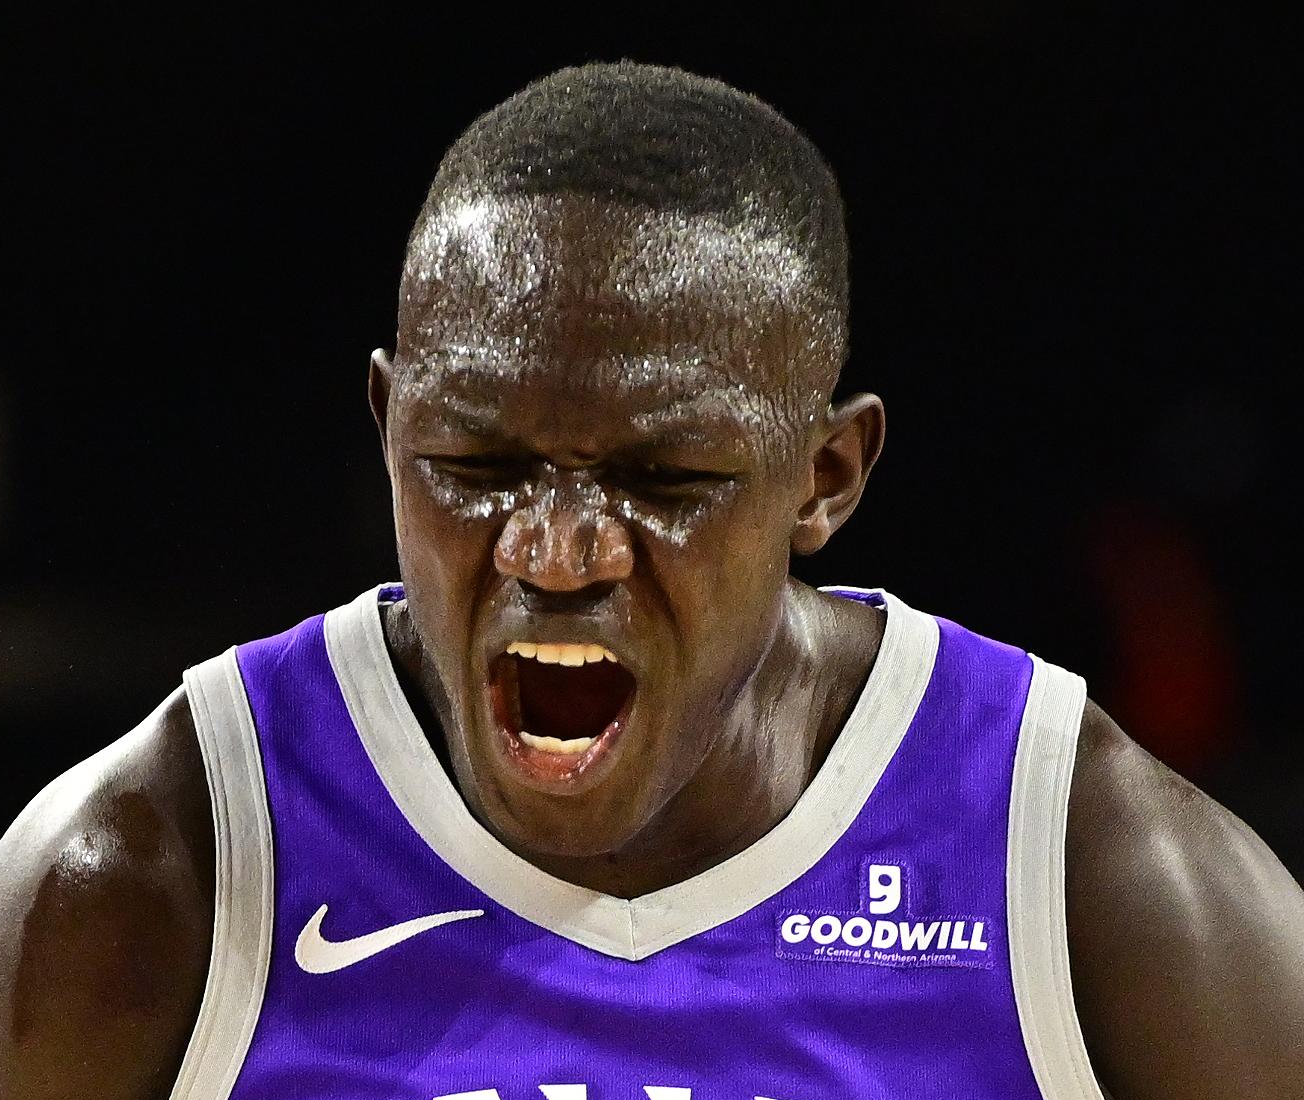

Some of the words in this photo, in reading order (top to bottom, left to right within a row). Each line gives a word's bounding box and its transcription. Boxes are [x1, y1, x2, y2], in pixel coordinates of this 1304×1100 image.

[781, 914, 988, 951] GOODWILL
[814, 946, 825, 956] of
[826, 946, 861, 958] Central
[864, 949, 871, 959] &
[873, 951, 917, 962] Northern
